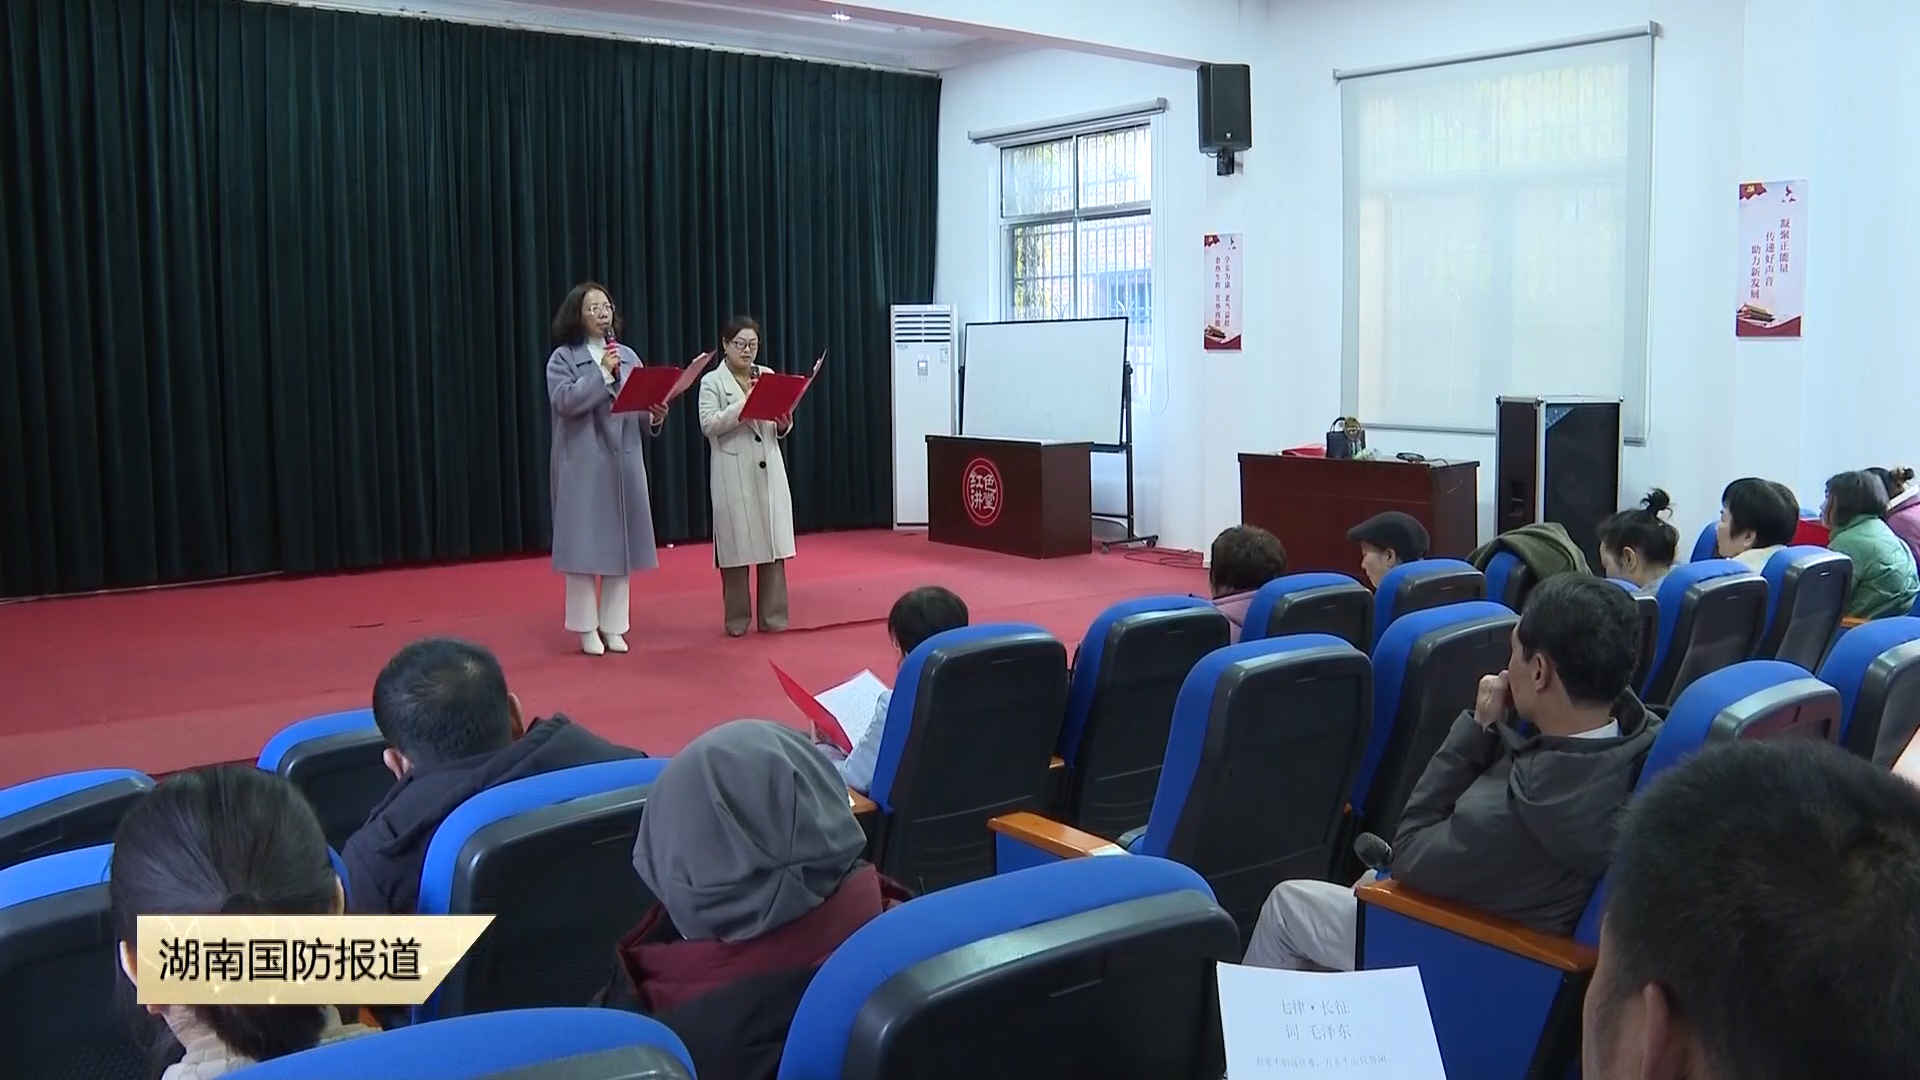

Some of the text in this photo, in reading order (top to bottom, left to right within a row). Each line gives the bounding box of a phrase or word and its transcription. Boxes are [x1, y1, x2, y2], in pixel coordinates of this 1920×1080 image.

[1765, 230, 1776, 287] 传递好声音
[1779, 217, 1791, 274] 凝聚正能量
[1750, 244, 1762, 300] 助力新发展
[969, 471, 998, 493] 红色
[970, 489, 997, 511] 讲堂
[1309, 1023, 1352, 1040] 毛泽东
